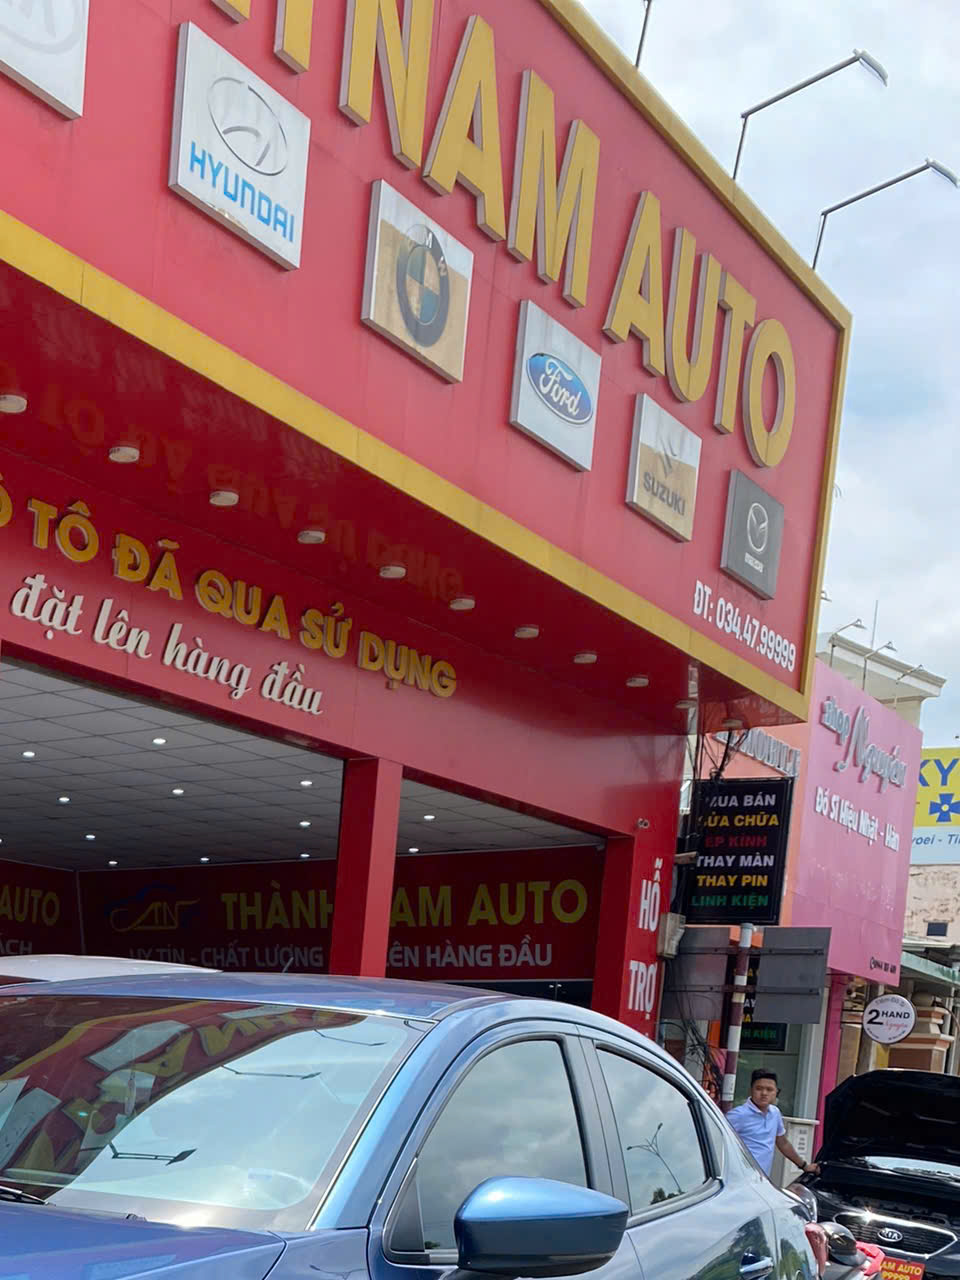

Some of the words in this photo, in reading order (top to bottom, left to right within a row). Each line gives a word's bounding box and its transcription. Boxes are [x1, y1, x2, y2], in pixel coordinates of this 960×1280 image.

[190, 142, 295, 243] HYUNDAI
[602, 190, 797, 468] AUTO
[643, 470, 686, 517] SUZUKI
[27, 498, 100, 562] TÔ
[112, 532, 184, 601] ĐÃ
[195, 569, 290, 640] QUA
[299, 602, 353, 659] SỬ
[357, 630, 457, 698] DỤNG
[10, 573, 84, 641] đặt
[93, 598, 153, 660] lên
[161, 622, 253, 701] hàng
[260, 662, 324, 717] đầu
[693, 579, 714, 624] ĐT:
[716, 597, 797, 673] 034.47.99999
[733, 811, 780, 827] CHỮA
[743, 791, 776, 807] BÁN
[696, 855, 736, 868] THAY
[739, 852, 775, 868] MÀN
[696, 874, 738, 887] THAY
[741, 874, 769, 887] PIN
[389, 884, 454, 928] AM
[467, 878, 589, 927] AUTO
[638, 857, 663, 932] HỖ
[200, 937, 251, 968] CHẤT
[387, 940, 421, 968] ÊN
[426, 938, 494, 968] HÀNG
[498, 933, 553, 968] ĐẦU
[628, 959, 658, 1020] TRỢ
[866, 1008, 884, 1026] 2
[881, 1010, 911, 1020] HAND
[881, 1261, 897, 1273] AM
[897, 1263, 922, 1276] AUTO
